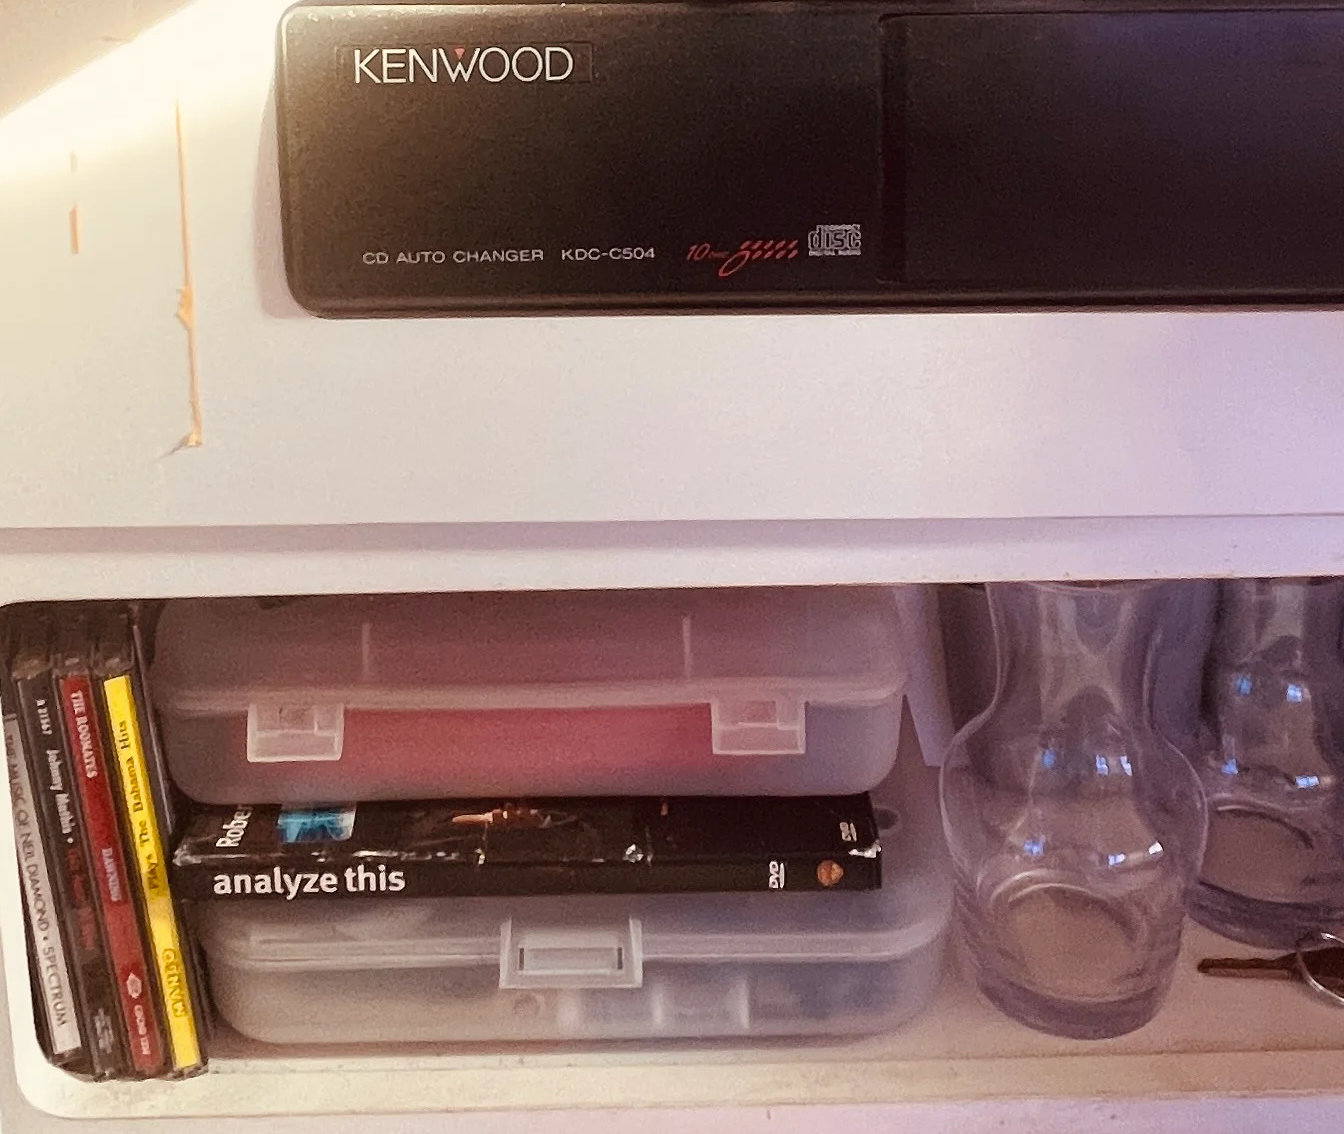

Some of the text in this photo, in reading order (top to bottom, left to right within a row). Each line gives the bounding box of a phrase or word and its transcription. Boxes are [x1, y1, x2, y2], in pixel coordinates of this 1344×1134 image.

[353, 45, 574, 84] KENWOOD
[362, 245, 656, 265] CD AUTO CHANGER KDC-C504
[686, 243, 711, 261] 10
[71, 690, 86, 715] THE
[46, 749, 76, 835] Johnny Mathis
[118, 720, 160, 891] Plays The Bahama Hits
[15, 809, 30, 827] OF
[19, 832, 37, 862] NEIL
[26, 864, 50, 933] DIAMOND
[213, 864, 406, 901] analyze this
[42, 946, 69, 1028] SPECTRUM
[162, 948, 189, 1018] MANGO
